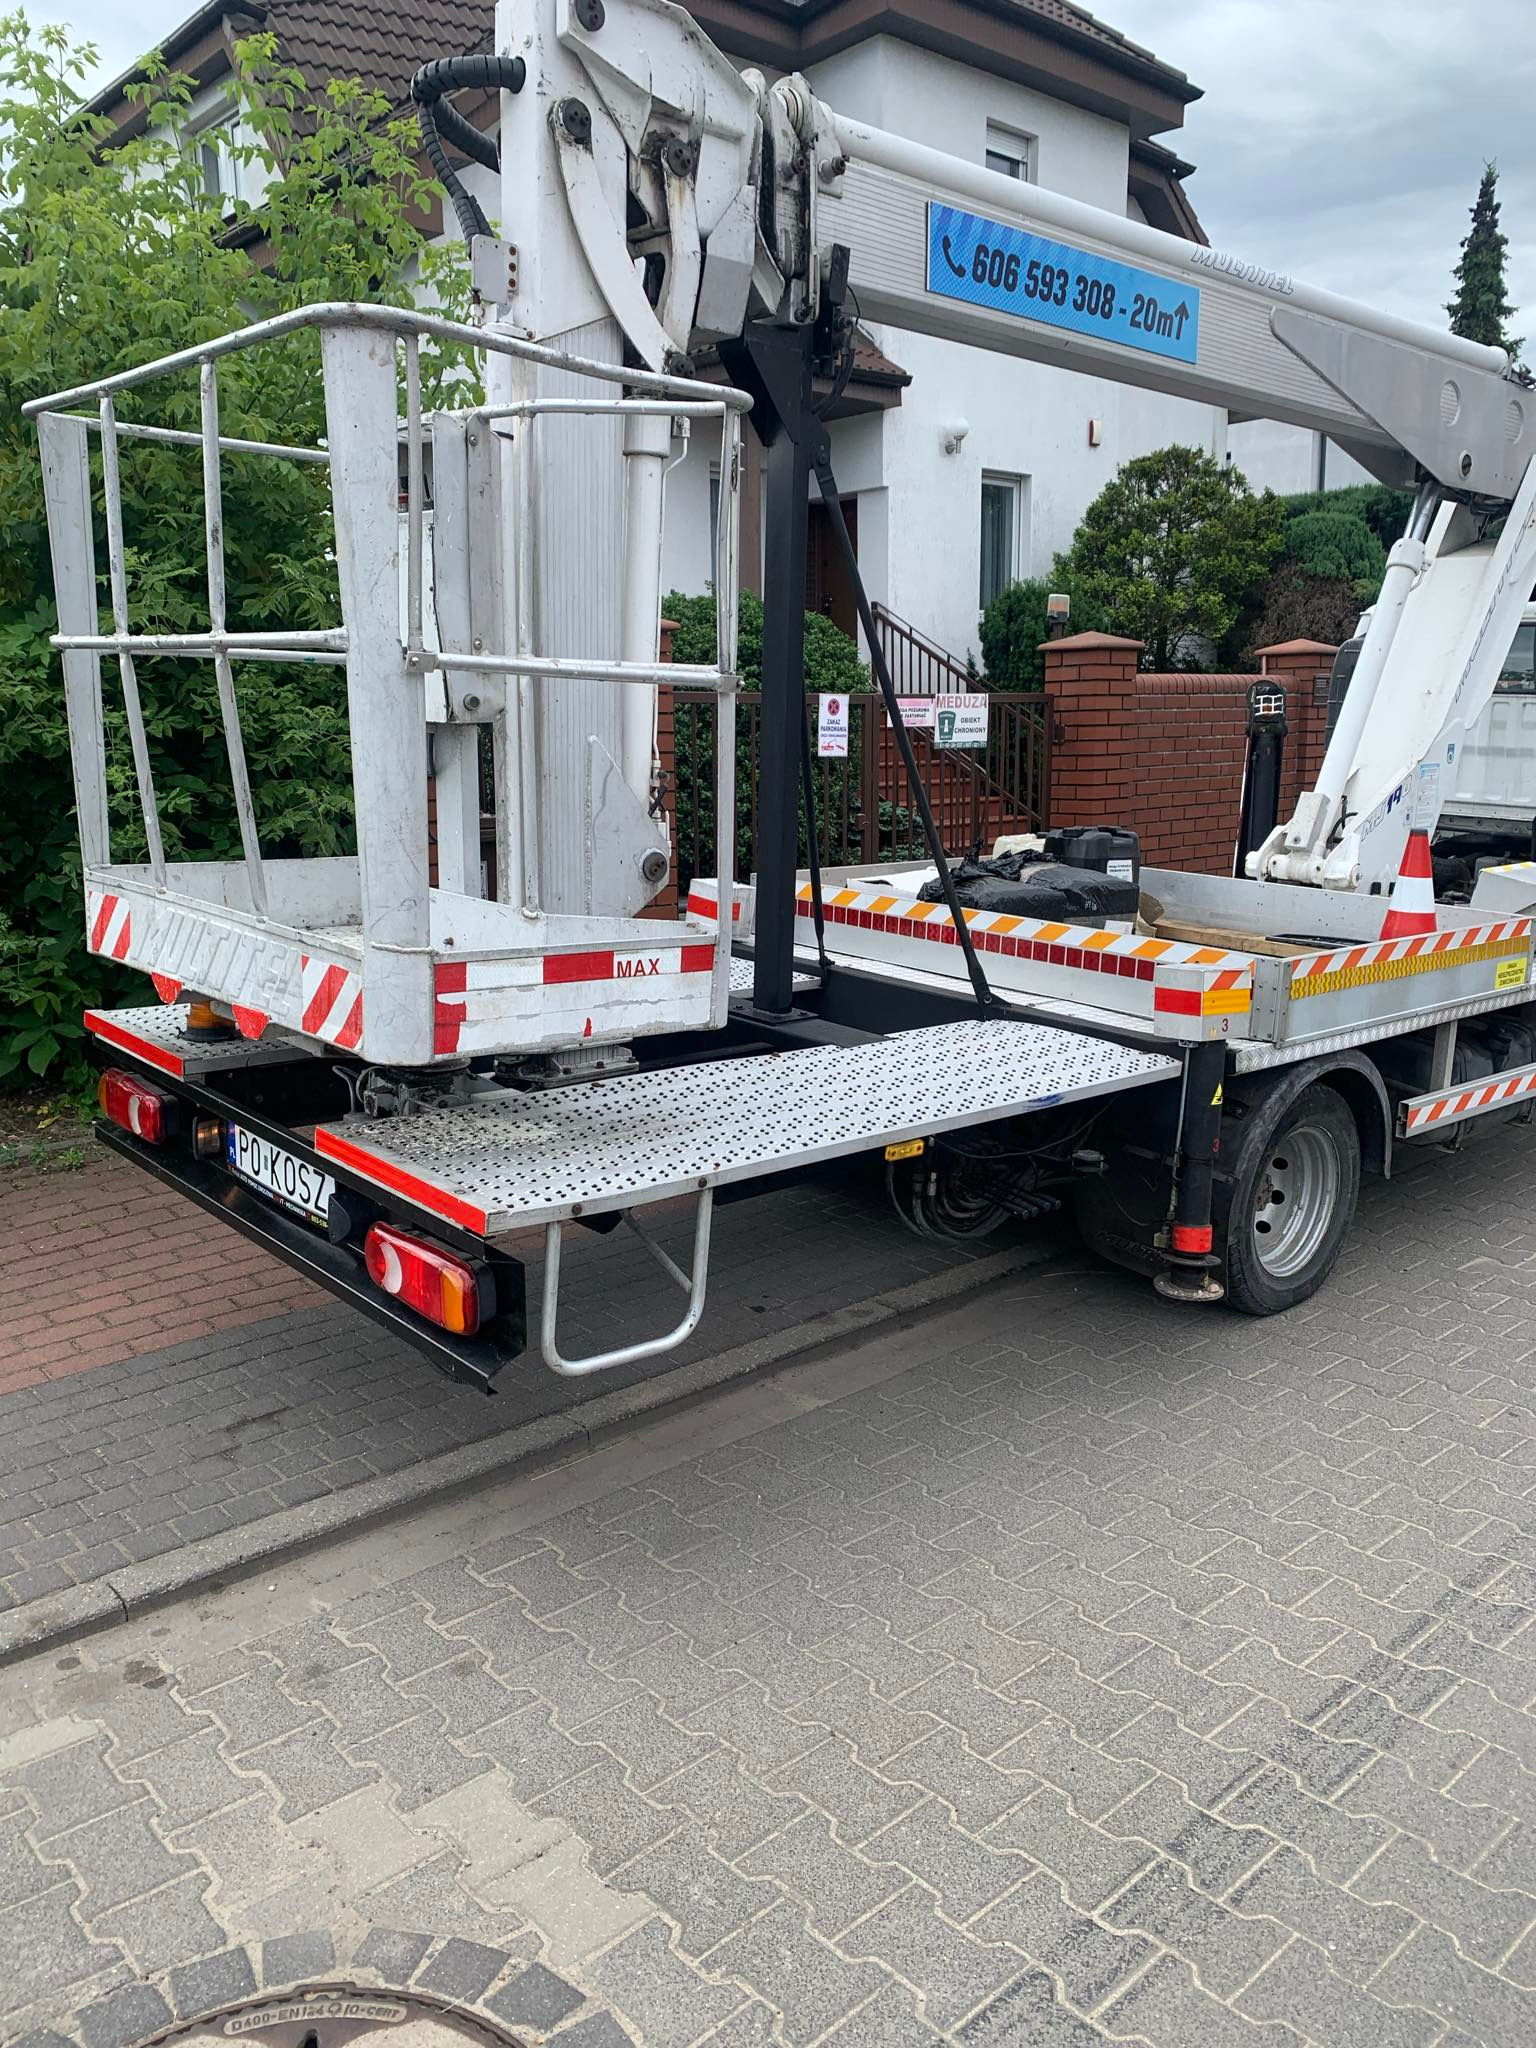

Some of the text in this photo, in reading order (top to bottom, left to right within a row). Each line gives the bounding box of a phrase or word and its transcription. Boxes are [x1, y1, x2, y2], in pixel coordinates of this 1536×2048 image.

[1190, 245, 1296, 296] MULTITEL
[972, 244, 1021, 292] 606
[1024, 260, 1069, 306] 593
[1073, 275, 1117, 320] 308
[1129, 293, 1173, 338] 20m
[936, 695, 988, 708] MEDUZA
[617, 957, 660, 978] MAX
[1221, 1018, 1229, 1032] 3
[229, 1146, 236, 1159] PL
[1211, 1138, 1220, 1152] 3
[270, 1146, 327, 1214] KOSZ
